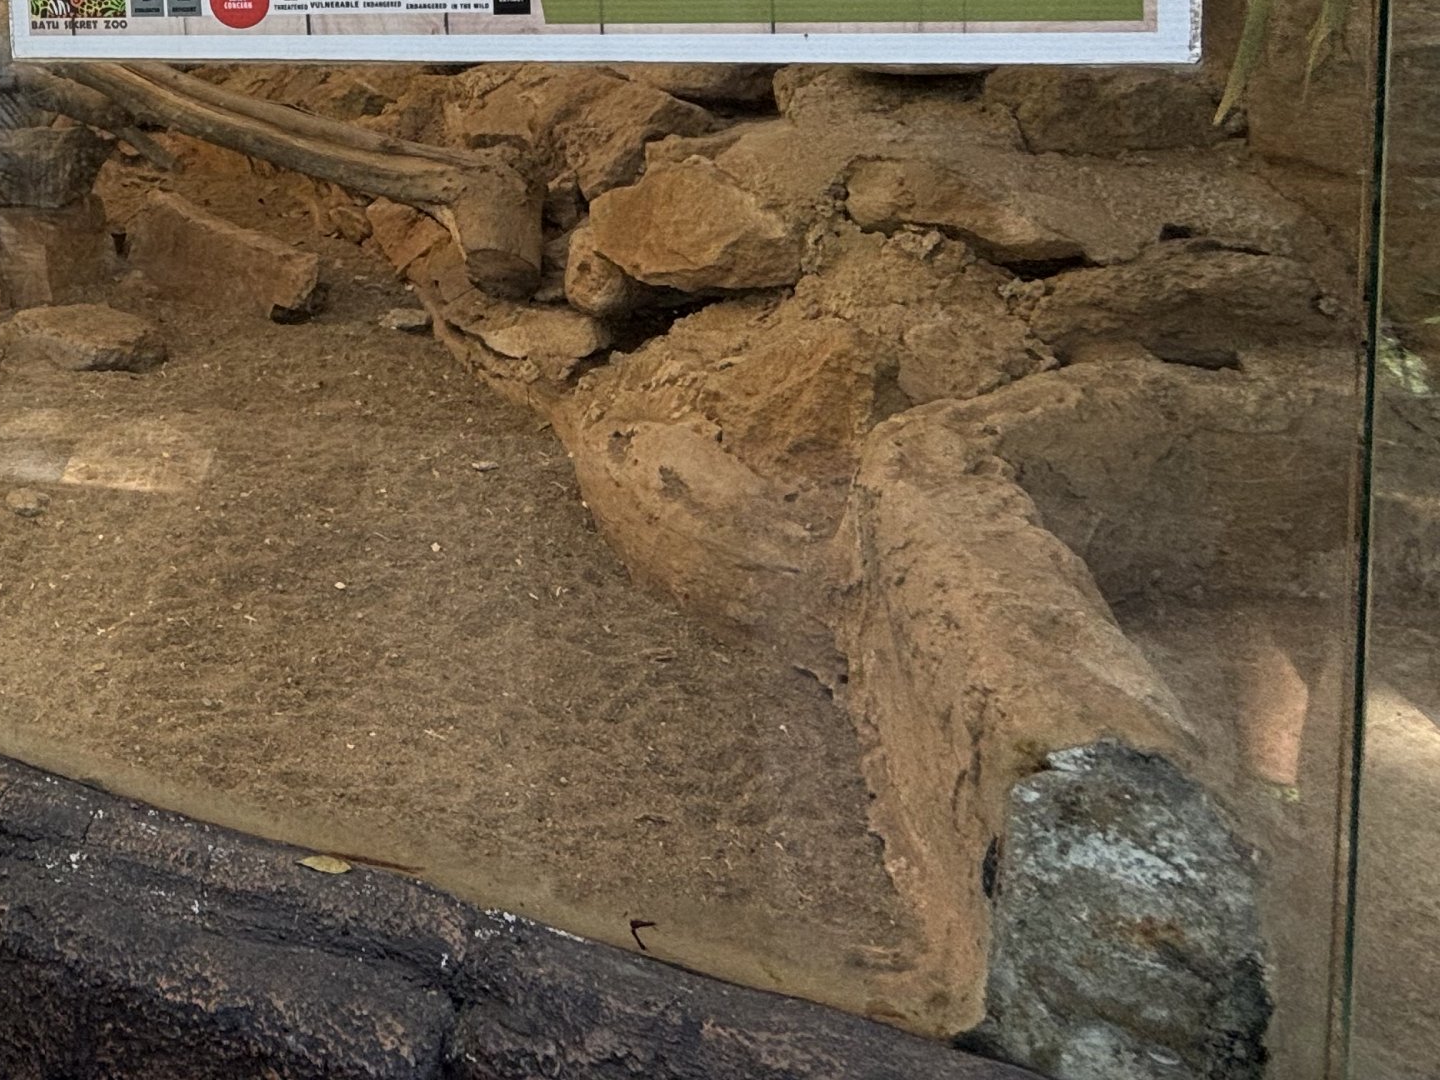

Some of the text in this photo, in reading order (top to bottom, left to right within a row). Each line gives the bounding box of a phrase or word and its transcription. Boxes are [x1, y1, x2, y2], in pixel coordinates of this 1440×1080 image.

[309, 0, 359, 9] VULNERABLE
[31, 20, 59, 30] BATU
[103, 19, 128, 29] ZOO
